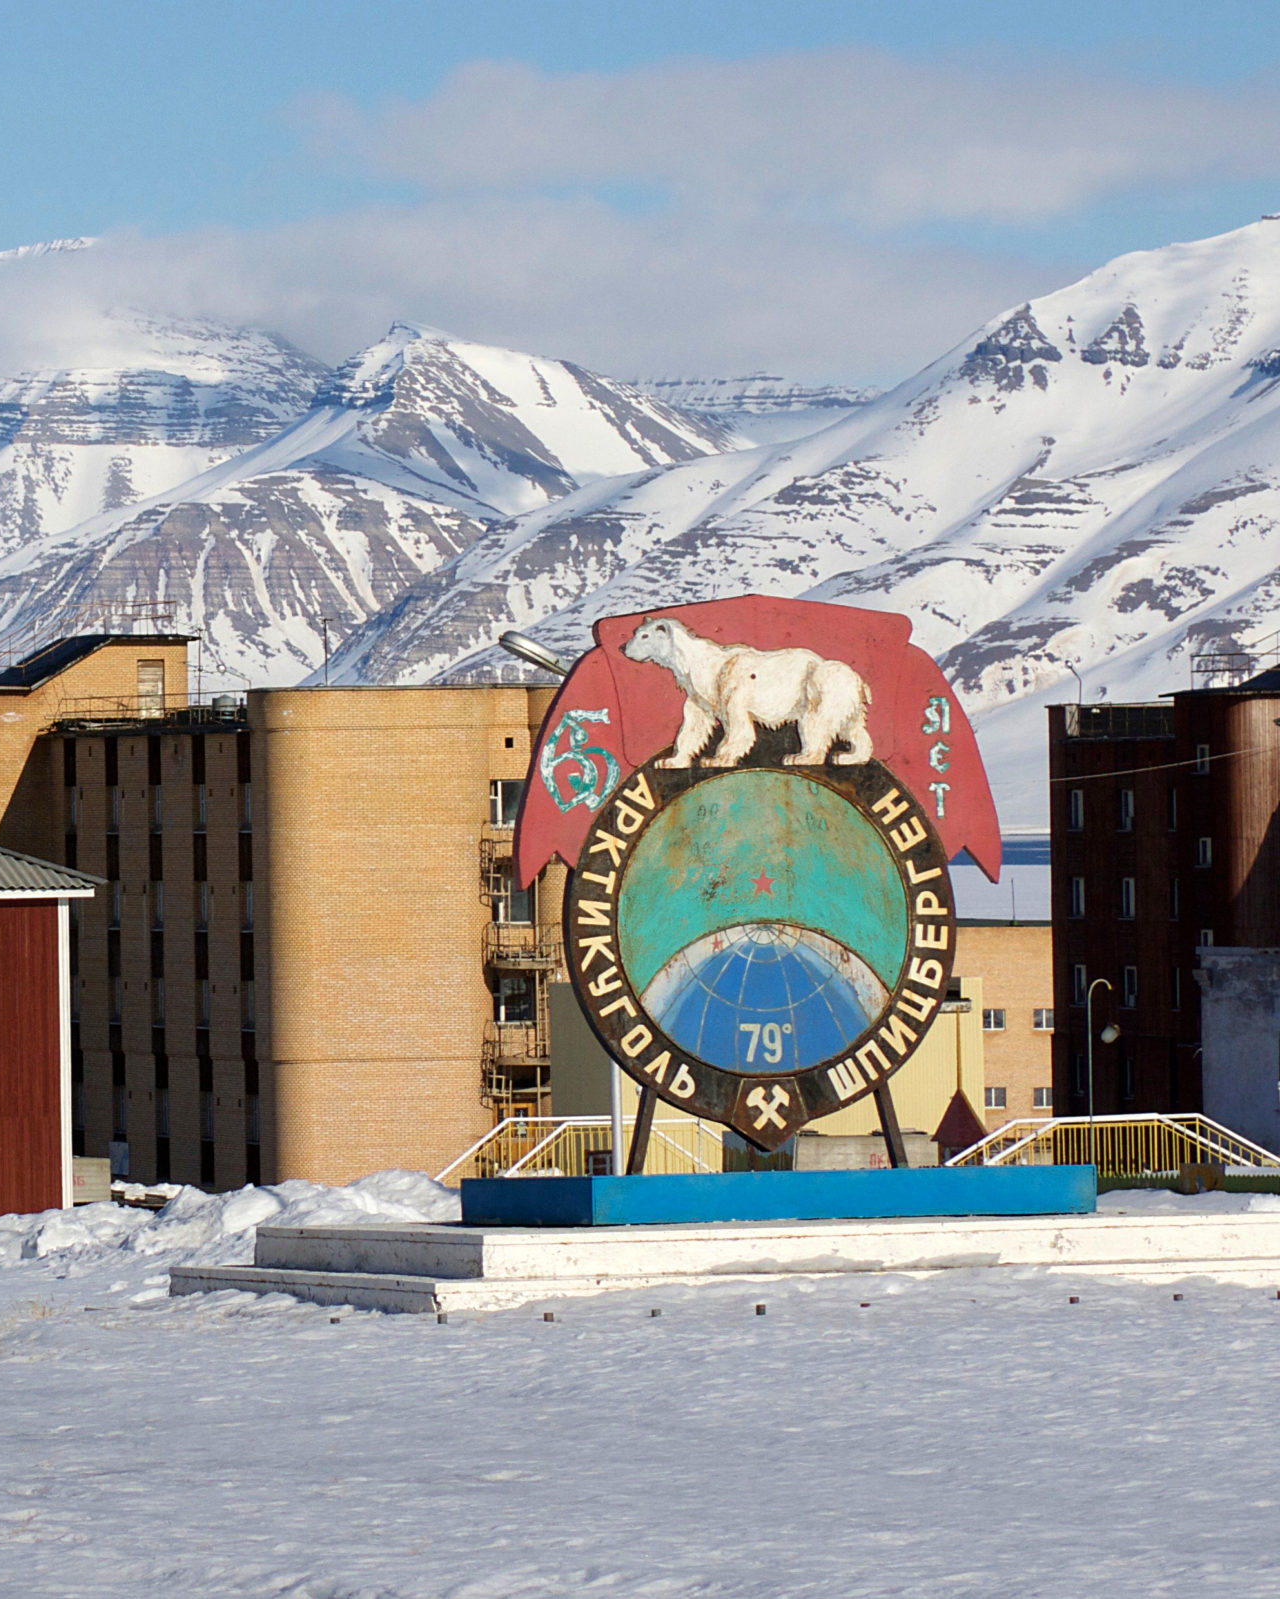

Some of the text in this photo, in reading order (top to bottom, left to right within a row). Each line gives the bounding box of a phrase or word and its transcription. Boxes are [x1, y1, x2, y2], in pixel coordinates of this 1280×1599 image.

[577, 772, 696, 1099] АРКТИКУГОЛЬ
[739, 1022, 792, 1064] 79°
[826, 787, 949, 1101] ШПИЦБЕРГЕН
